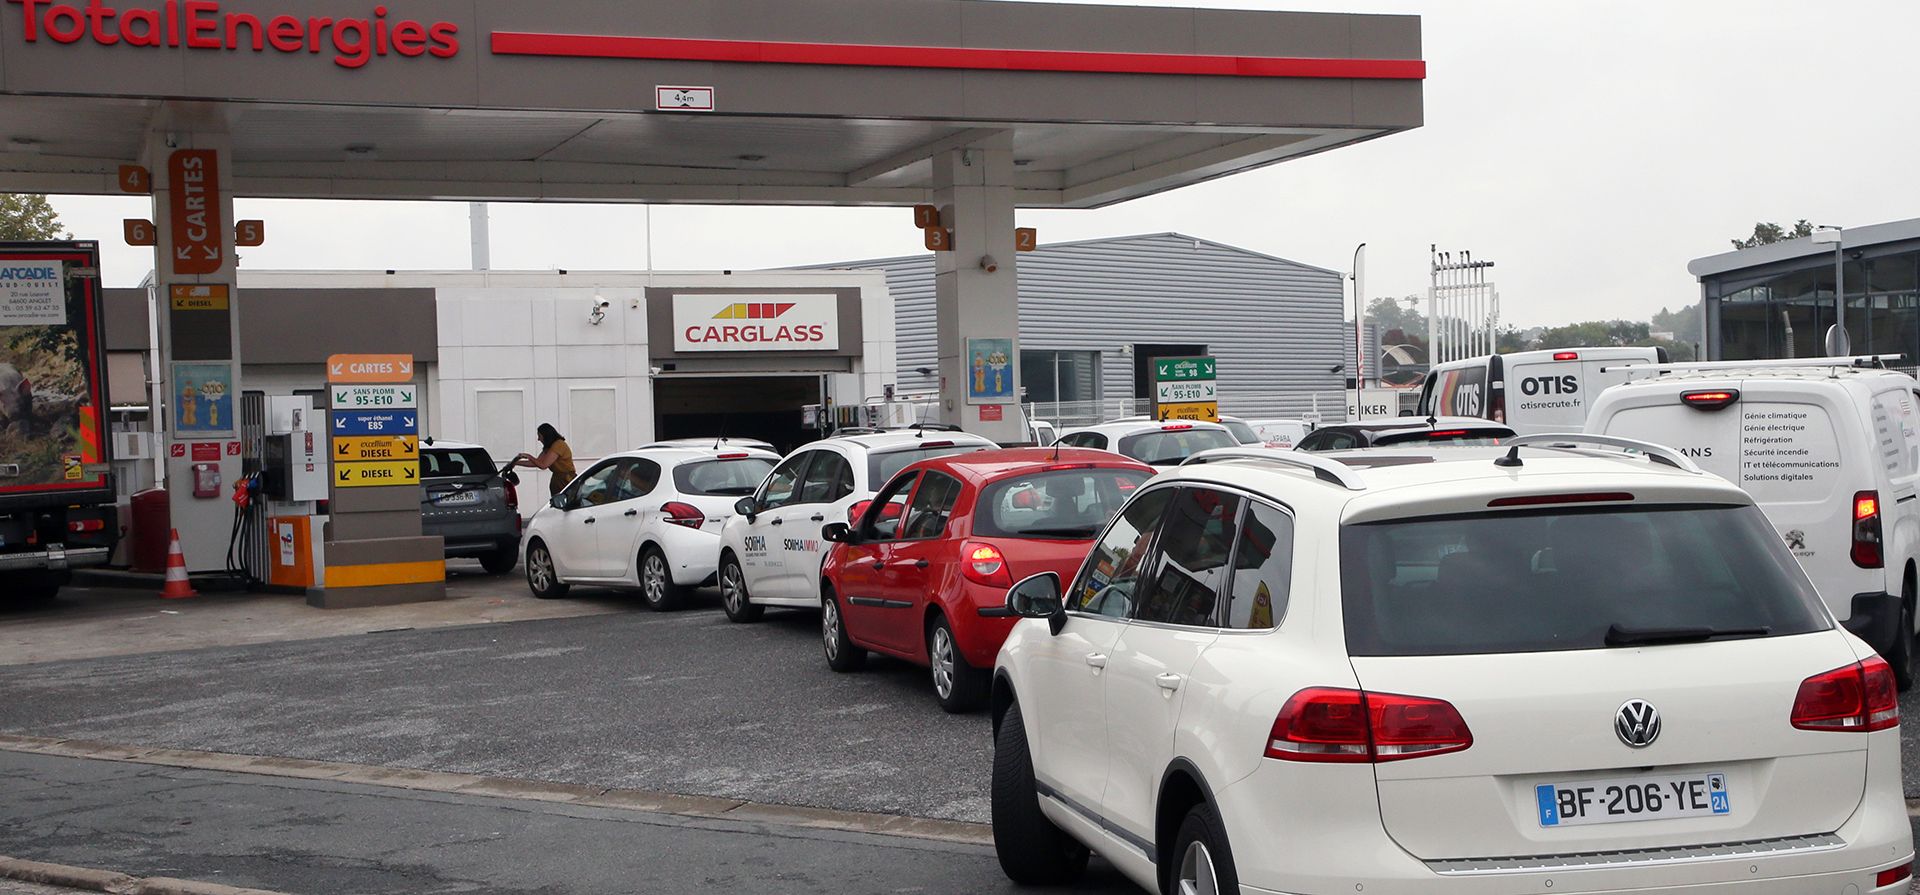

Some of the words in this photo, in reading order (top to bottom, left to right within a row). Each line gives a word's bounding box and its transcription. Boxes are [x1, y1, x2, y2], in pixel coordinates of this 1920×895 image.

[7, 0, 459, 68] TotalEnergies
[127, 171, 139, 187] 4
[183, 156, 208, 242] CARTES
[922, 209, 930, 223] 1
[132, 224, 145, 241] 6
[245, 225, 256, 241] 5
[932, 232, 941, 246] 3
[1020, 232, 1030, 247] 2
[0, 267, 57, 279] ARCADIE
[685, 325, 824, 343] CARGLASS
[350, 362, 393, 374] CARTES
[1189, 369, 1198, 377] 98
[1521, 375, 1578, 396] OTIS
[355, 395, 393, 405] 95-E10
[1173, 390, 1201, 399] 95-E10
[1456, 383, 1480, 416] OTIS
[1520, 399, 1581, 410] otisrecrute.fr
[1767, 412, 1807, 420] climatique
[368, 421, 384, 430] E85
[1767, 424, 1805, 432] électrique
[1744, 436, 1793, 445] Réfrigération
[360, 449, 393, 458] DIESEL
[361, 469, 393, 478] DIESEL
[1780, 473, 1814, 482] digitales
[1546, 809, 1552, 819] F
[1557, 780, 1709, 819] BF-206-YE
[1712, 796, 1728, 811] 2A
